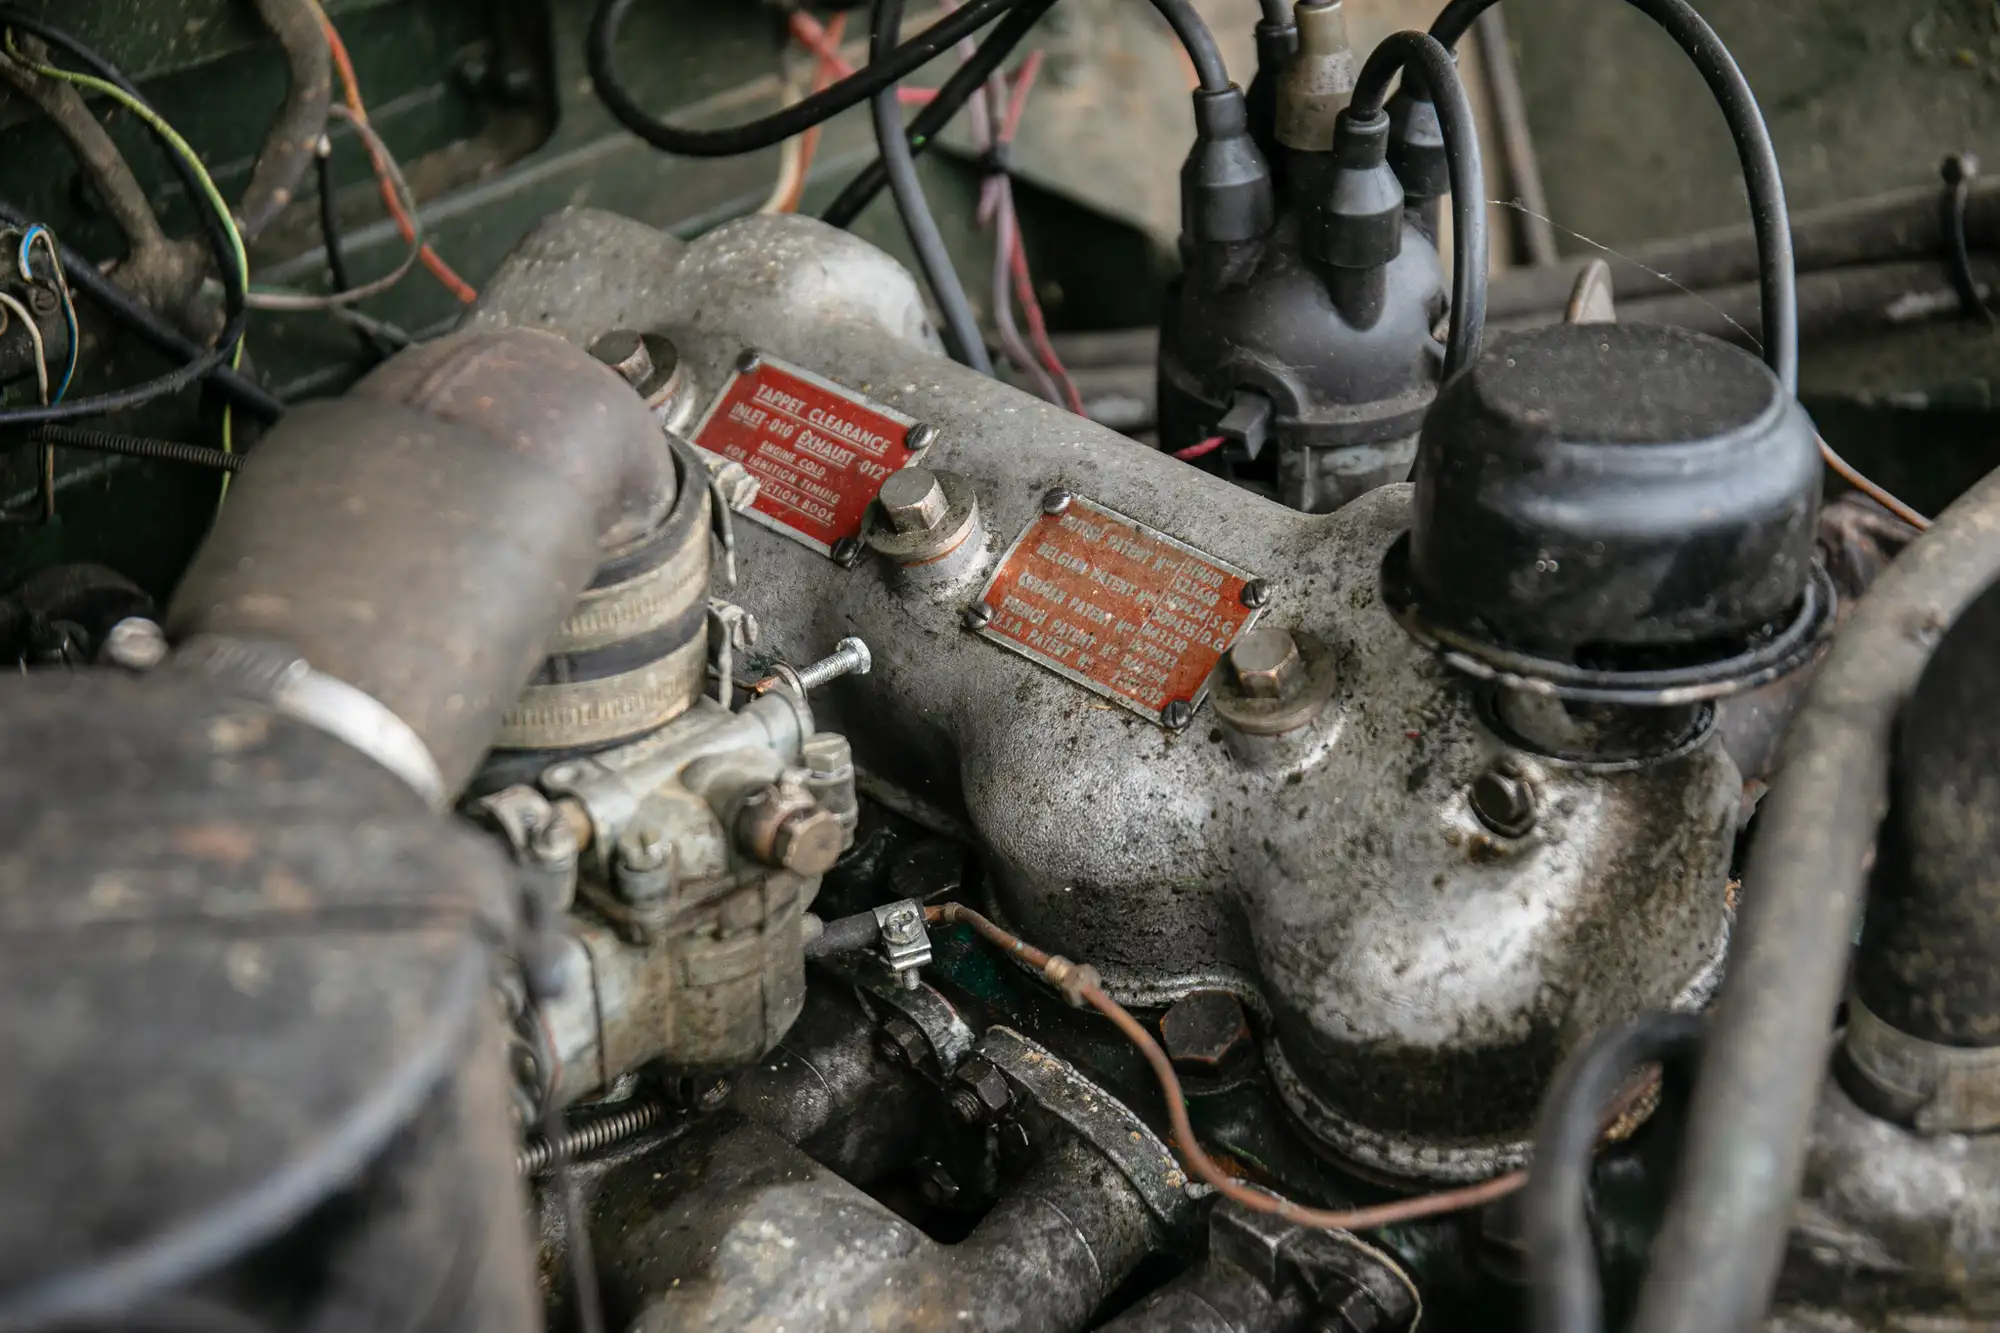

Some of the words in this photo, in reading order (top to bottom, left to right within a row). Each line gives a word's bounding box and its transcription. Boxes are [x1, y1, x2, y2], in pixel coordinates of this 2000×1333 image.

[729, 400, 768, 425] INLET
[795, 428, 858, 467] EXHAUST
[752, 383, 807, 415] TAPPET
[805, 407, 893, 454] CLEARANCE
[723, 442, 748, 460] FOR
[746, 452, 799, 486] IGNITION
[798, 477, 841, 505] TIMING
[758, 439, 797, 464] ENGINE
[1034, 541, 1089, 575] BELGIAN
[1088, 566, 1138, 598] PATENT
[1103, 533, 1153, 565] PATENT
[1014, 570, 1068, 606] GERMAN
[1066, 596, 1116, 628] PATENT
[1025, 627, 1074, 660] PATENT
[1048, 617, 1098, 651] PATENT
